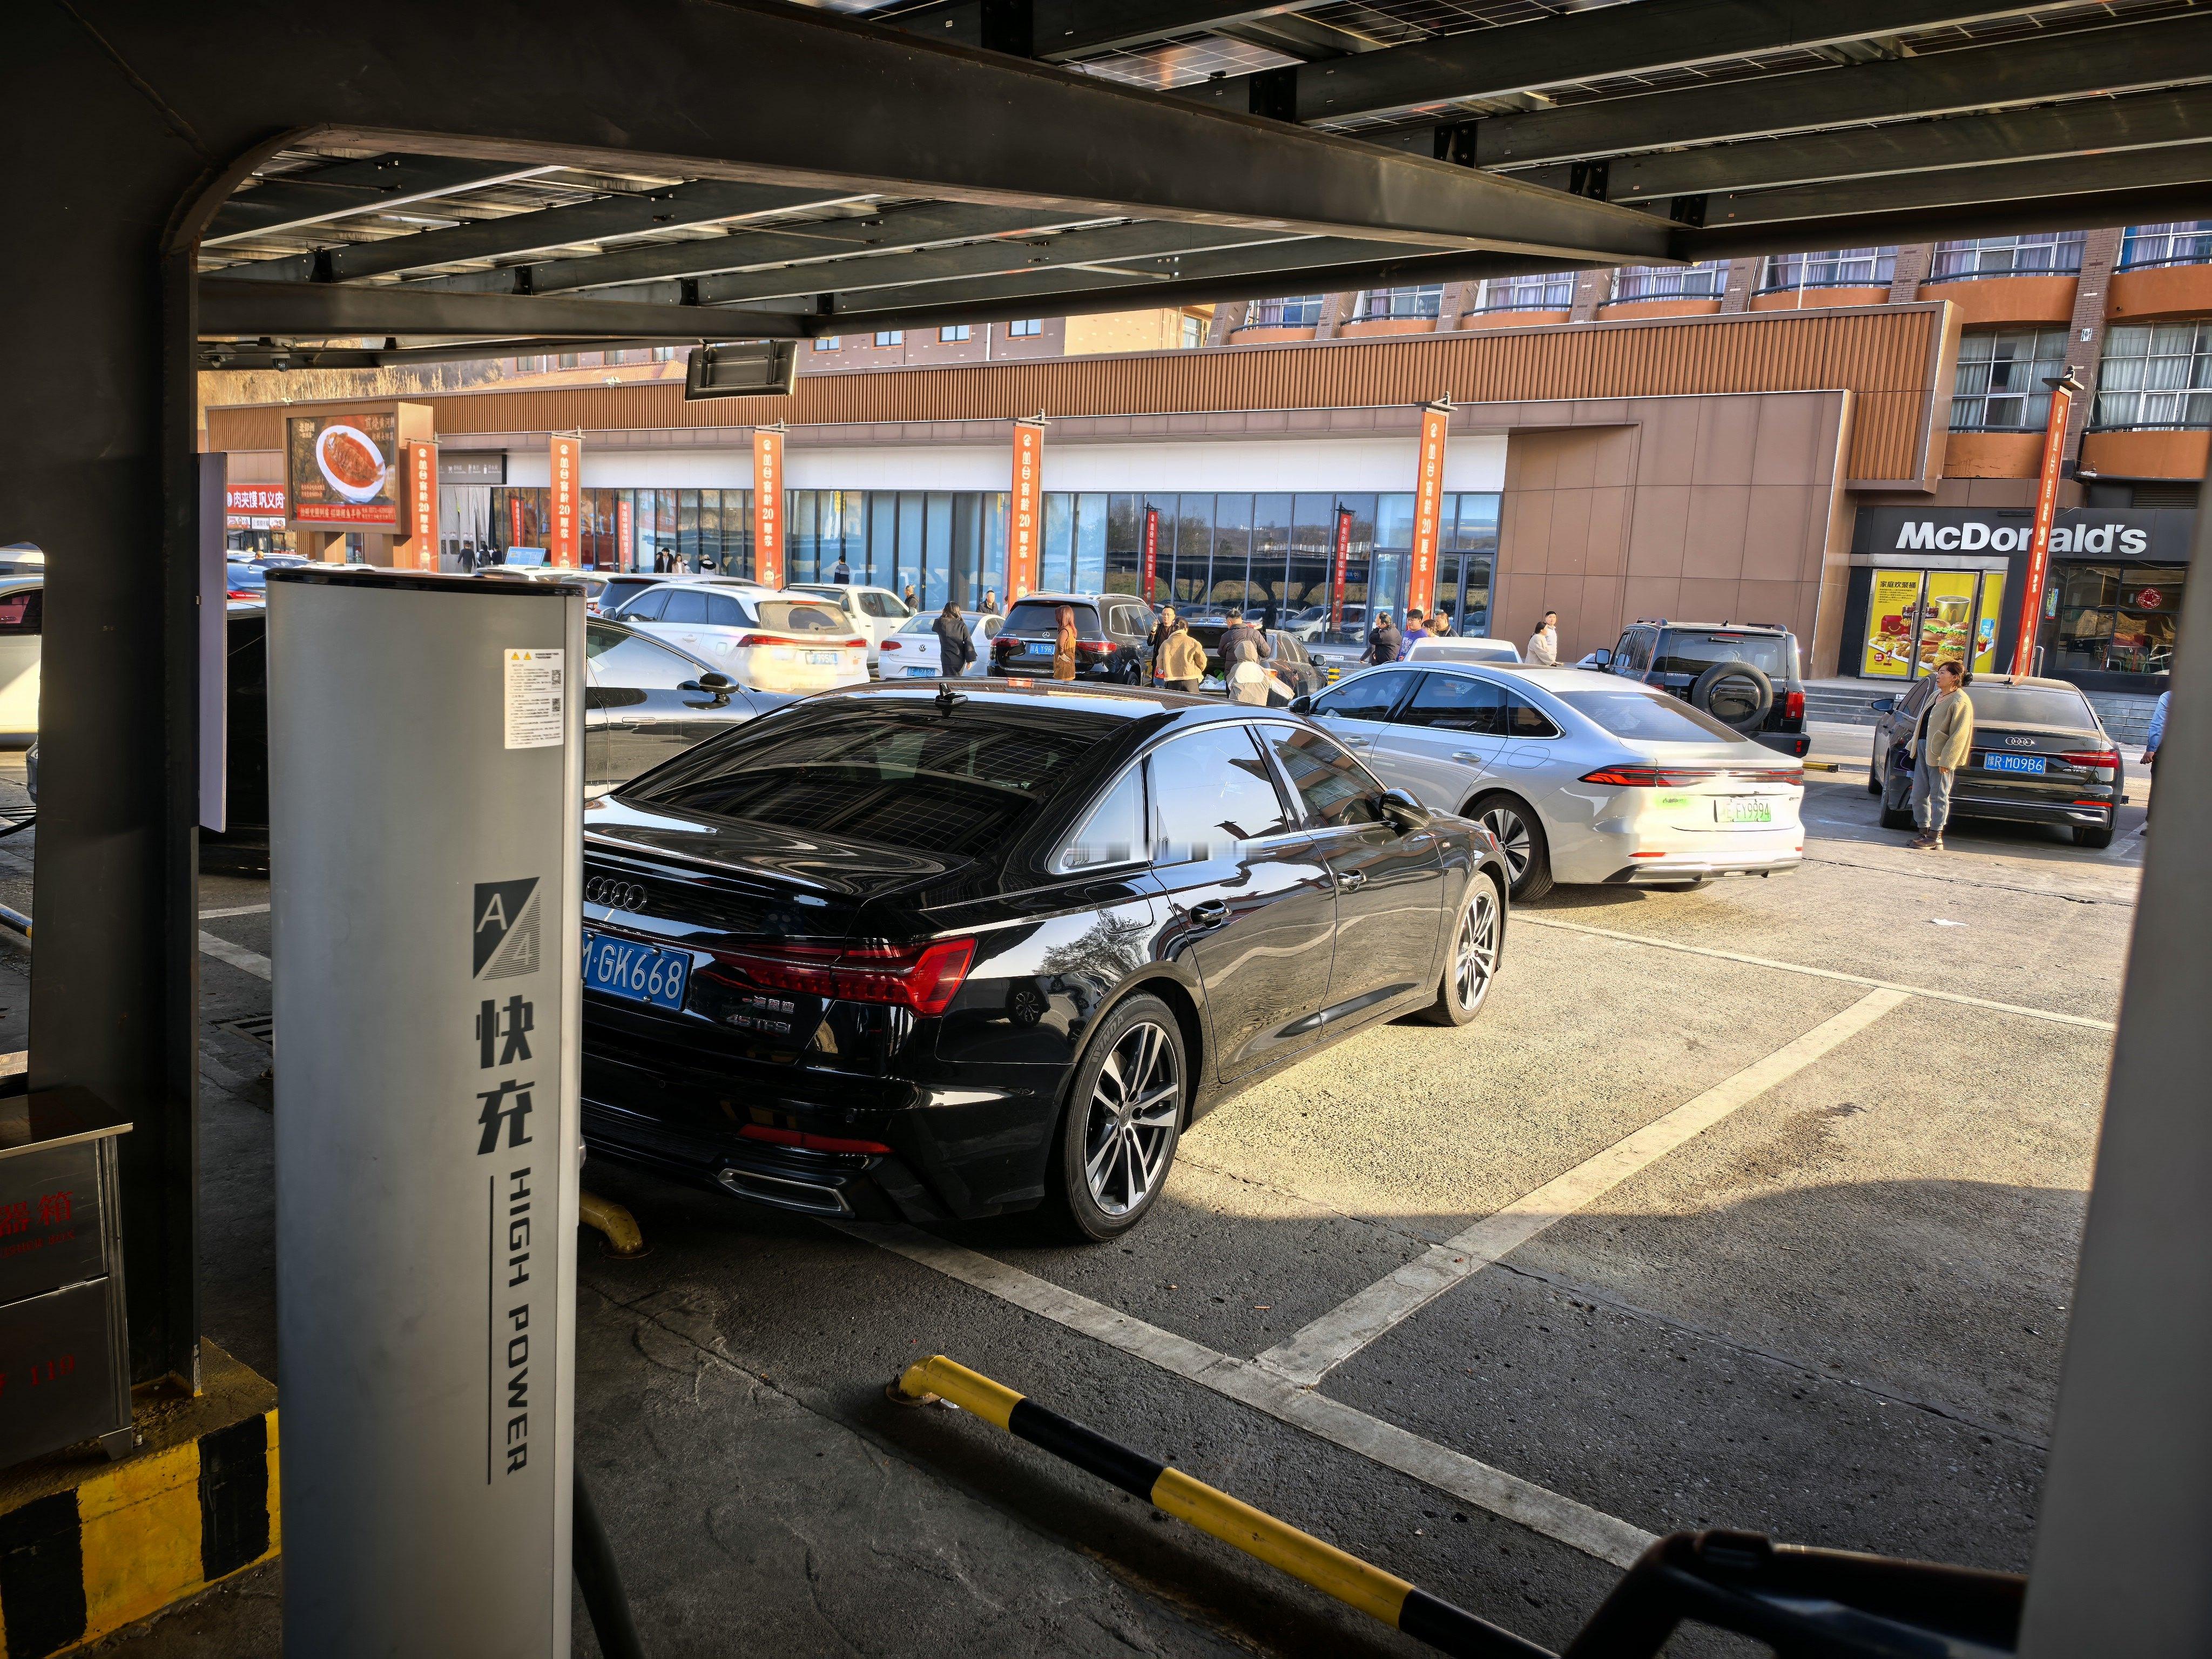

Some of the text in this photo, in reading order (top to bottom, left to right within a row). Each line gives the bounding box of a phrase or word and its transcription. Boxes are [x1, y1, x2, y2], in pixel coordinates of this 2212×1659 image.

[233, 490, 258, 508] 肉夹馍
[258, 490, 285, 508] 巩义肉
[1879, 581, 1917, 589] 家庭欢聚桶
[476, 994, 535, 1156] 快充
[507, 1167, 531, 1476] HIGH POWER
[31, 1353, 75, 1386] 119
